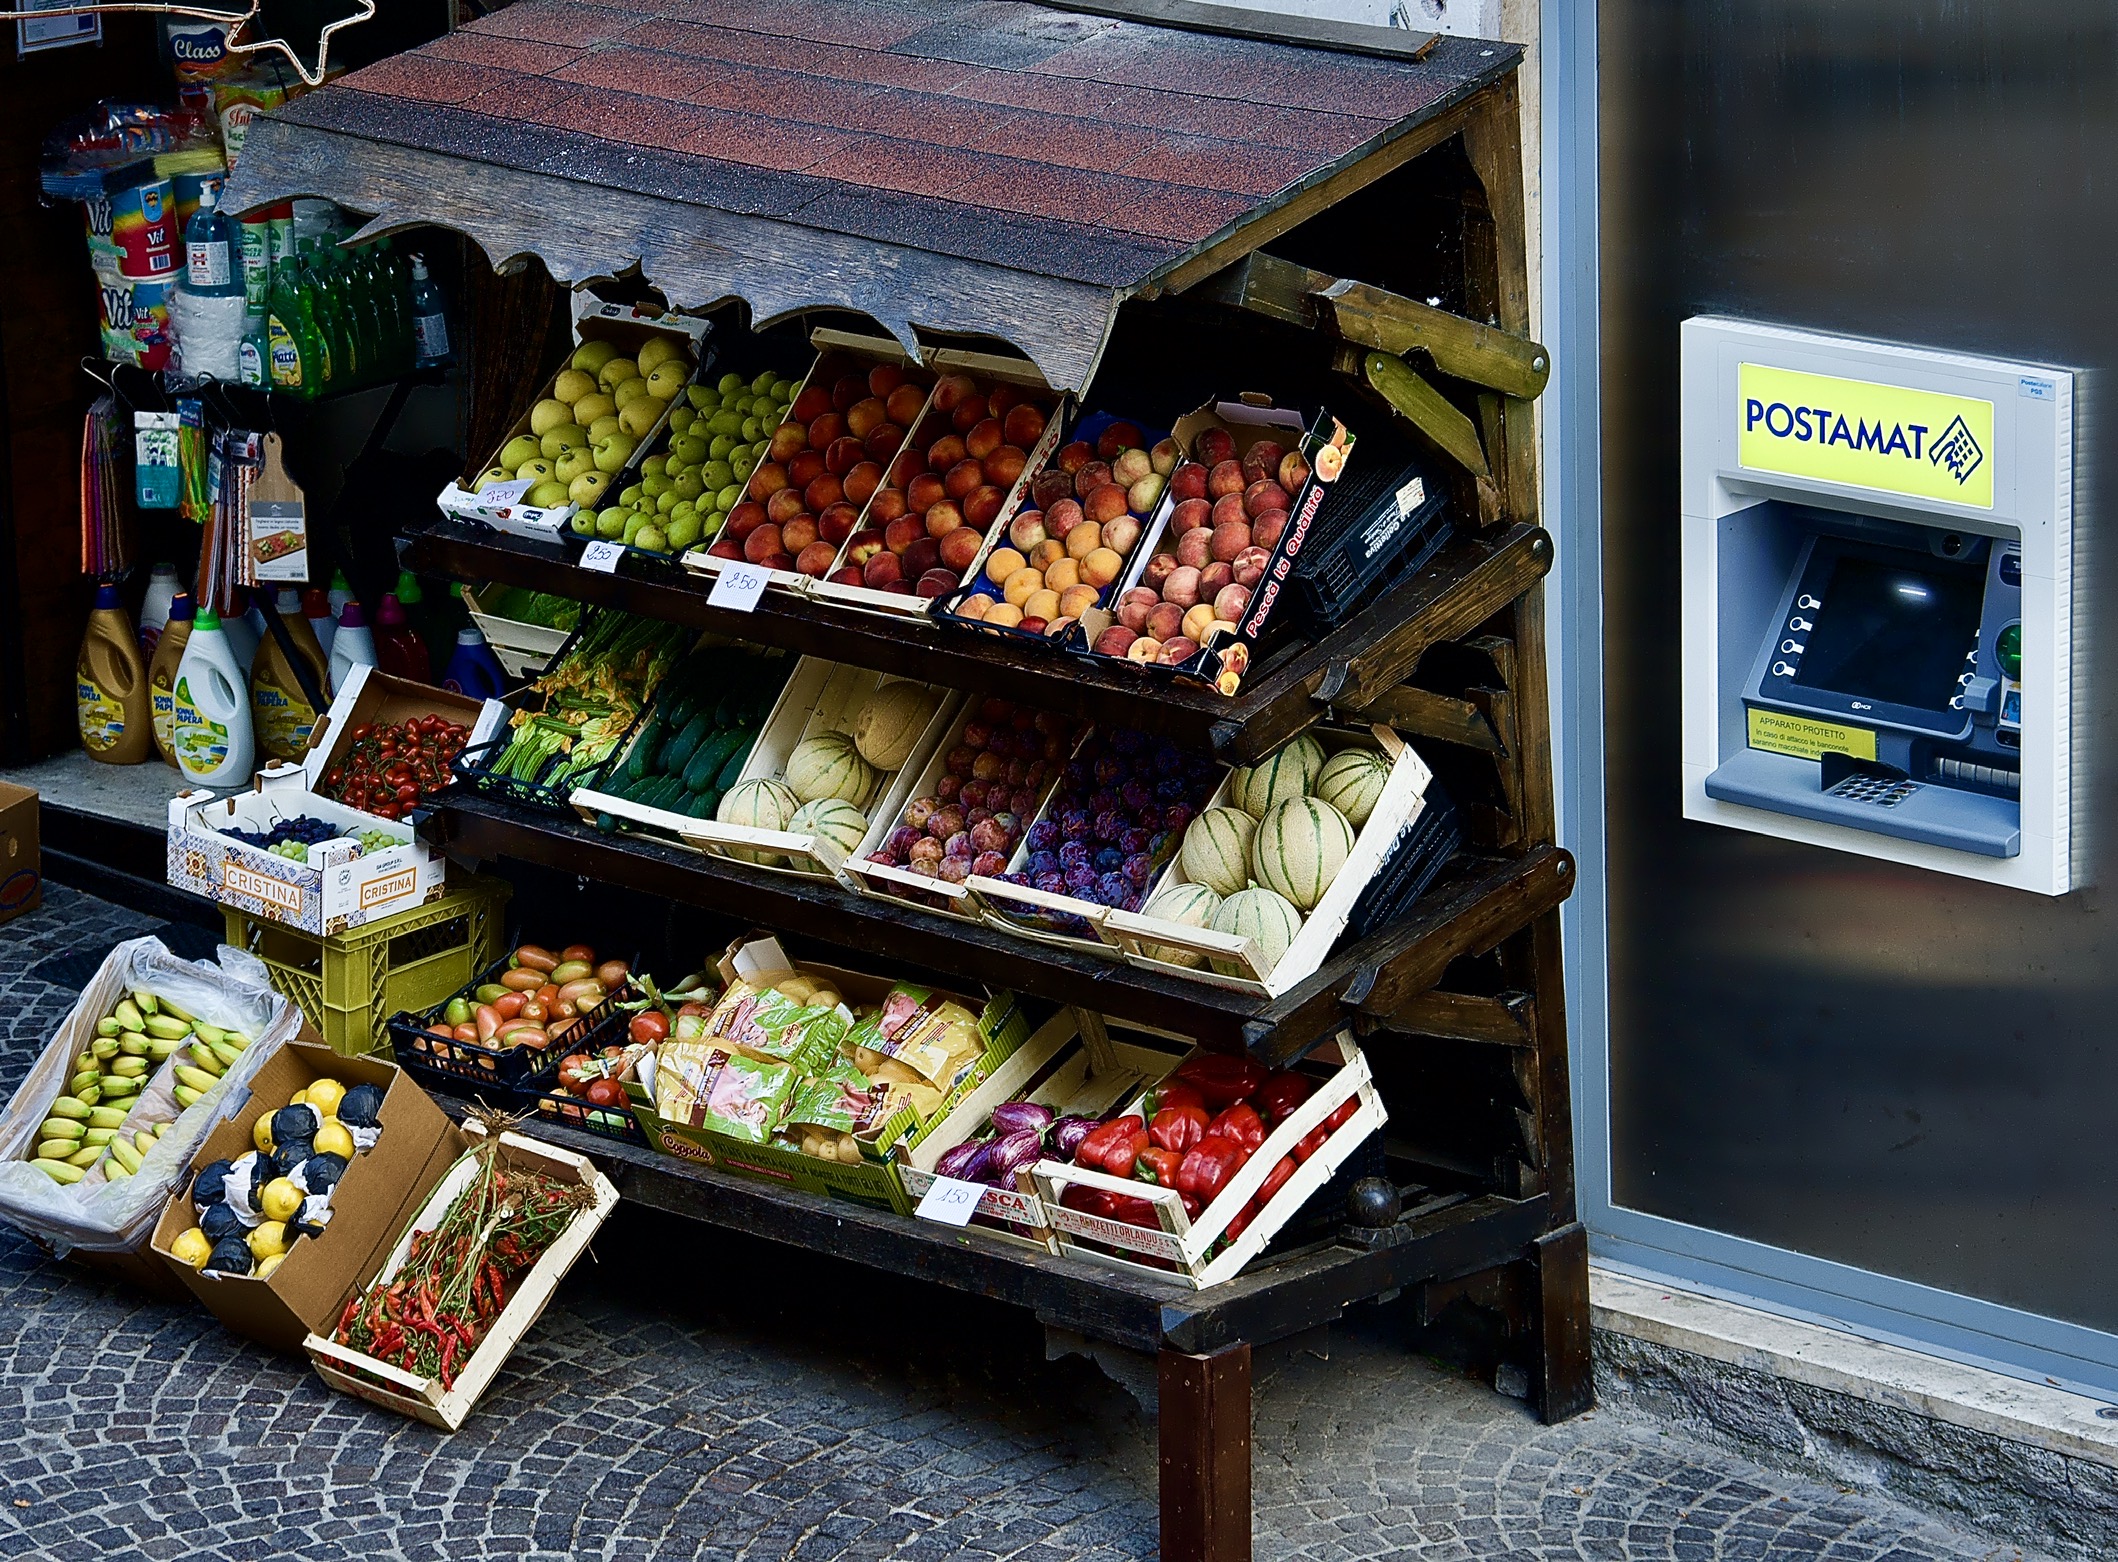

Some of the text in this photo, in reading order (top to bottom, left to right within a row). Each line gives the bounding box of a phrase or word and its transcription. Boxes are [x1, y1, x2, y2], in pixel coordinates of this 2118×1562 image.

[175, 39, 220, 58] Class
[86, 200, 112, 233] Vit
[147, 227, 165, 245] Vit
[102, 288, 133, 328] Vit
[135, 306, 149, 319] Vit
[1747, 398, 1928, 459] POSTAMAT
[177, 714, 203, 724] PAPERA
[1760, 716, 1846, 741] APPARATO PROTETTO
[1752, 738, 1777, 749] saranno
[1778, 743, 1809, 755] macchiate
[1755, 728, 1763, 736] In
[1764, 731, 1779, 740] caso
[1779, 732, 1786, 741] di
[1787, 735, 1809, 746] attacco
[1810, 739, 1816, 747] le
[228, 870, 297, 906] CRISTINA
[364, 876, 411, 900] CRISTINA
[662, 1131, 711, 1161] Coppola
[980, 1190, 1026, 1211] SCA
